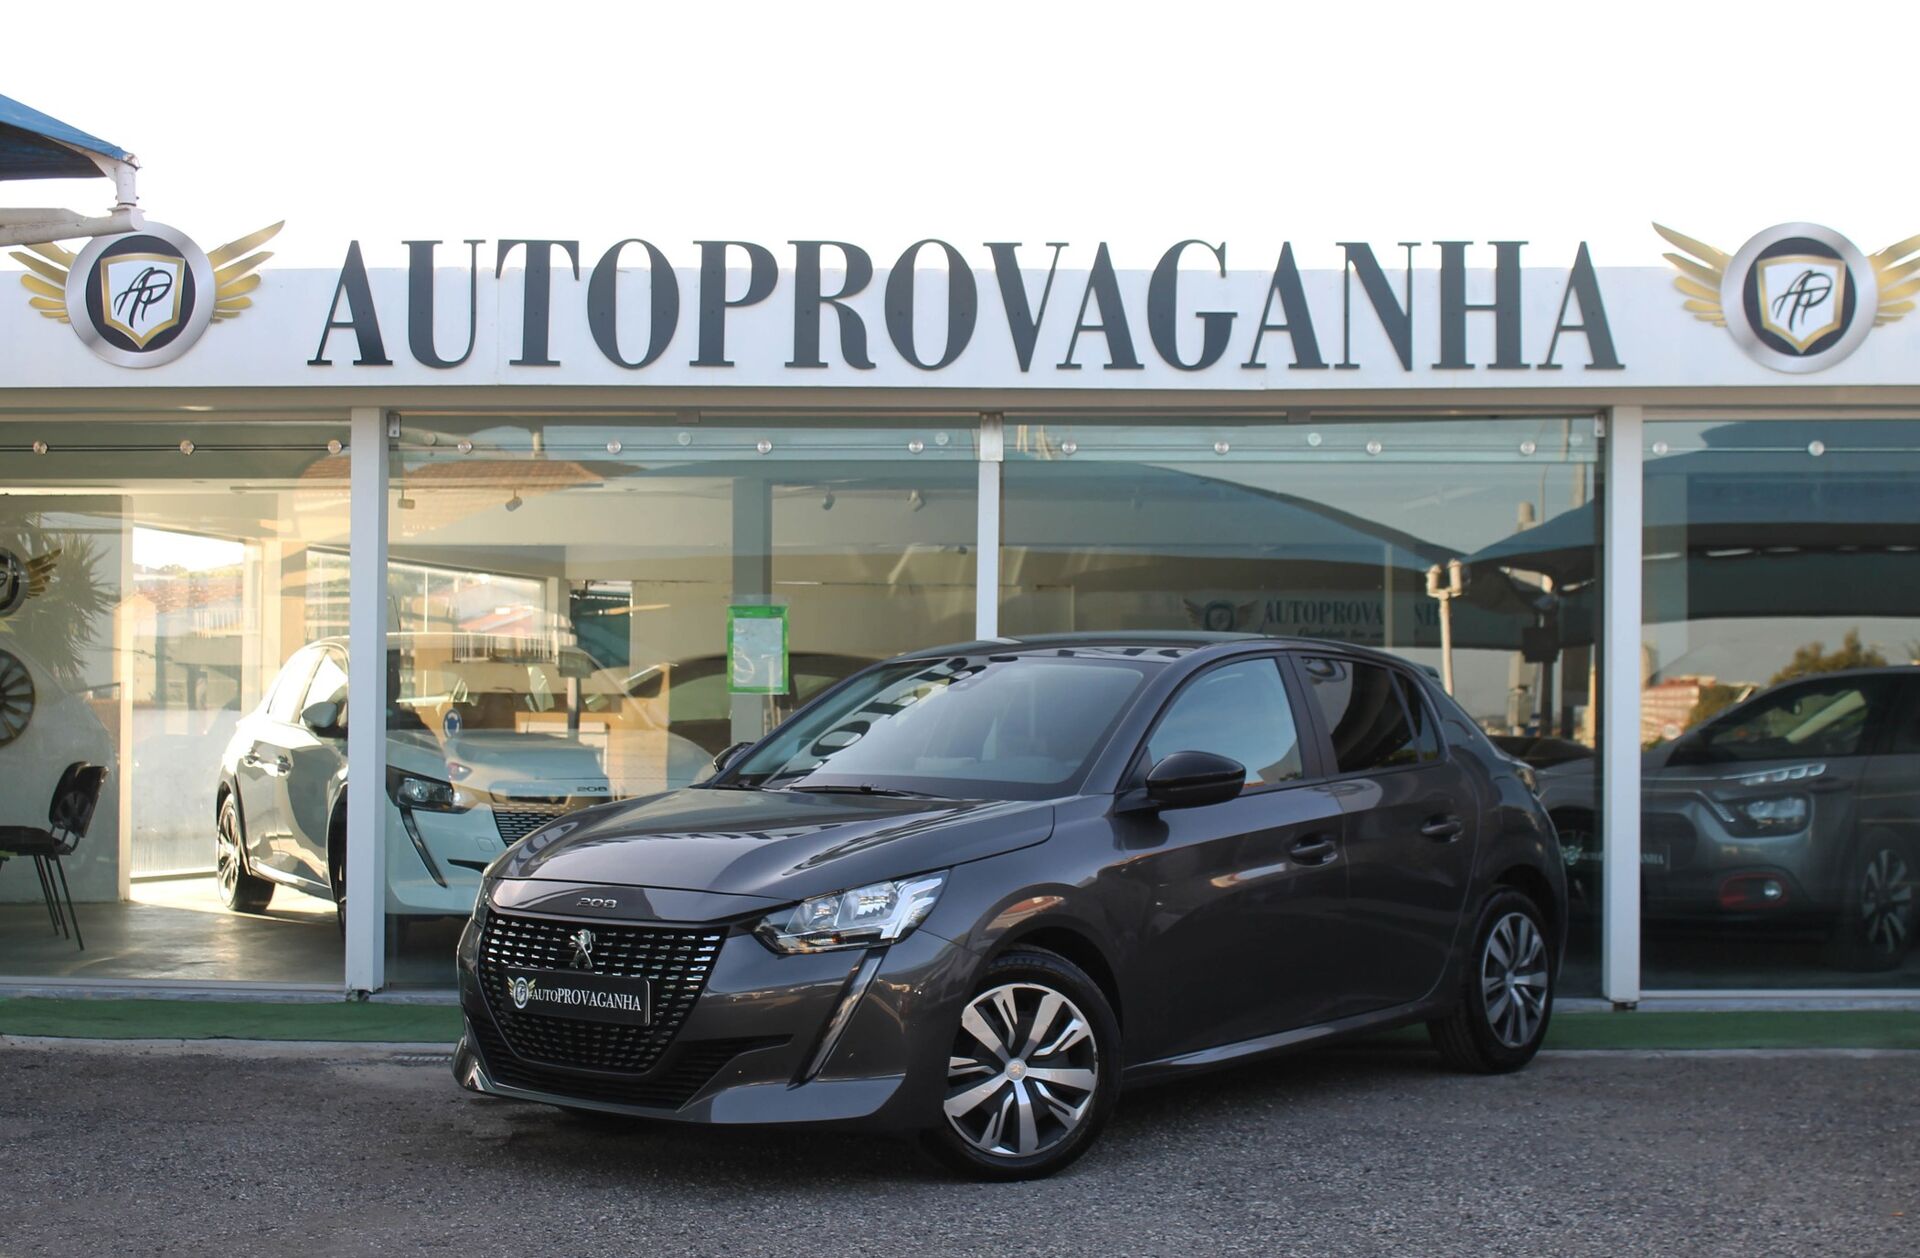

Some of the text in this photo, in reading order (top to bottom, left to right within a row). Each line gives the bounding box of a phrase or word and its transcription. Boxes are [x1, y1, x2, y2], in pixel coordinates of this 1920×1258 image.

[307, 238, 1626, 373] AUTOPROVAGANHA
[576, 897, 618, 910] 208
[531, 987, 642, 1012] AUTOPROVAGANHA
